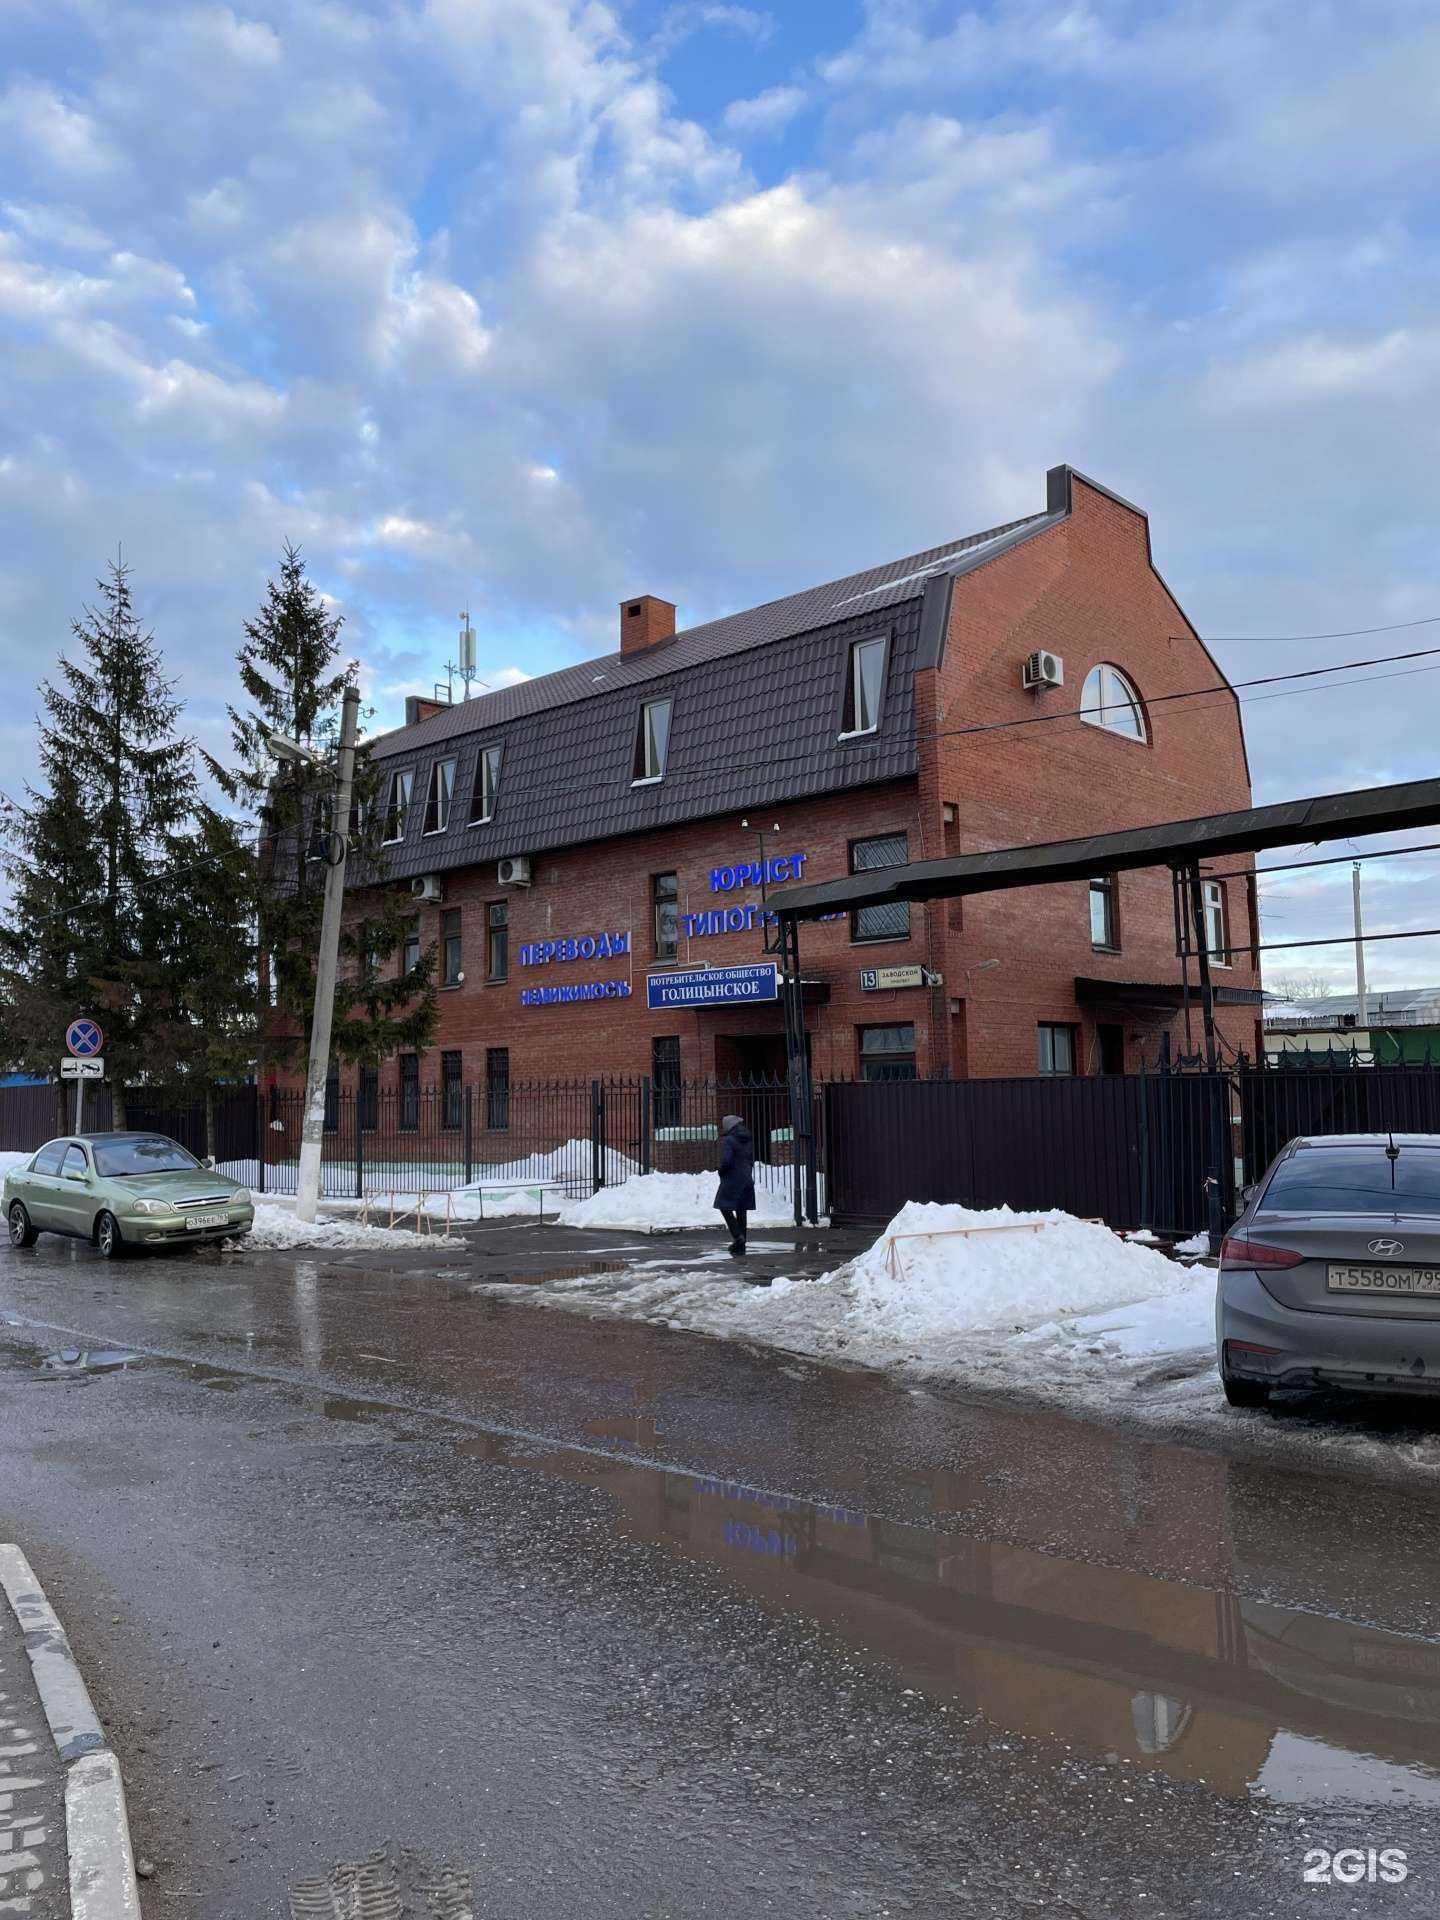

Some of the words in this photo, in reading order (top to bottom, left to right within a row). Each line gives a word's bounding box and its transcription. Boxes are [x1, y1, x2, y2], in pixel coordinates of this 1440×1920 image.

[709, 854, 807, 892] ЮРИСТ
[519, 931, 631, 966] ПЕРЕВОДЫ
[650, 971, 725, 986] ПОТРЕБИТЕЛЬСКОЕ
[726, 967, 772, 979] ОБЩЕСТВО
[863, 972, 876, 987] 13
[520, 980, 632, 1005] НЕДВИЖИМОСТЬ
[662, 981, 760, 1001] ГОЛИЦЫНСКОЕ
